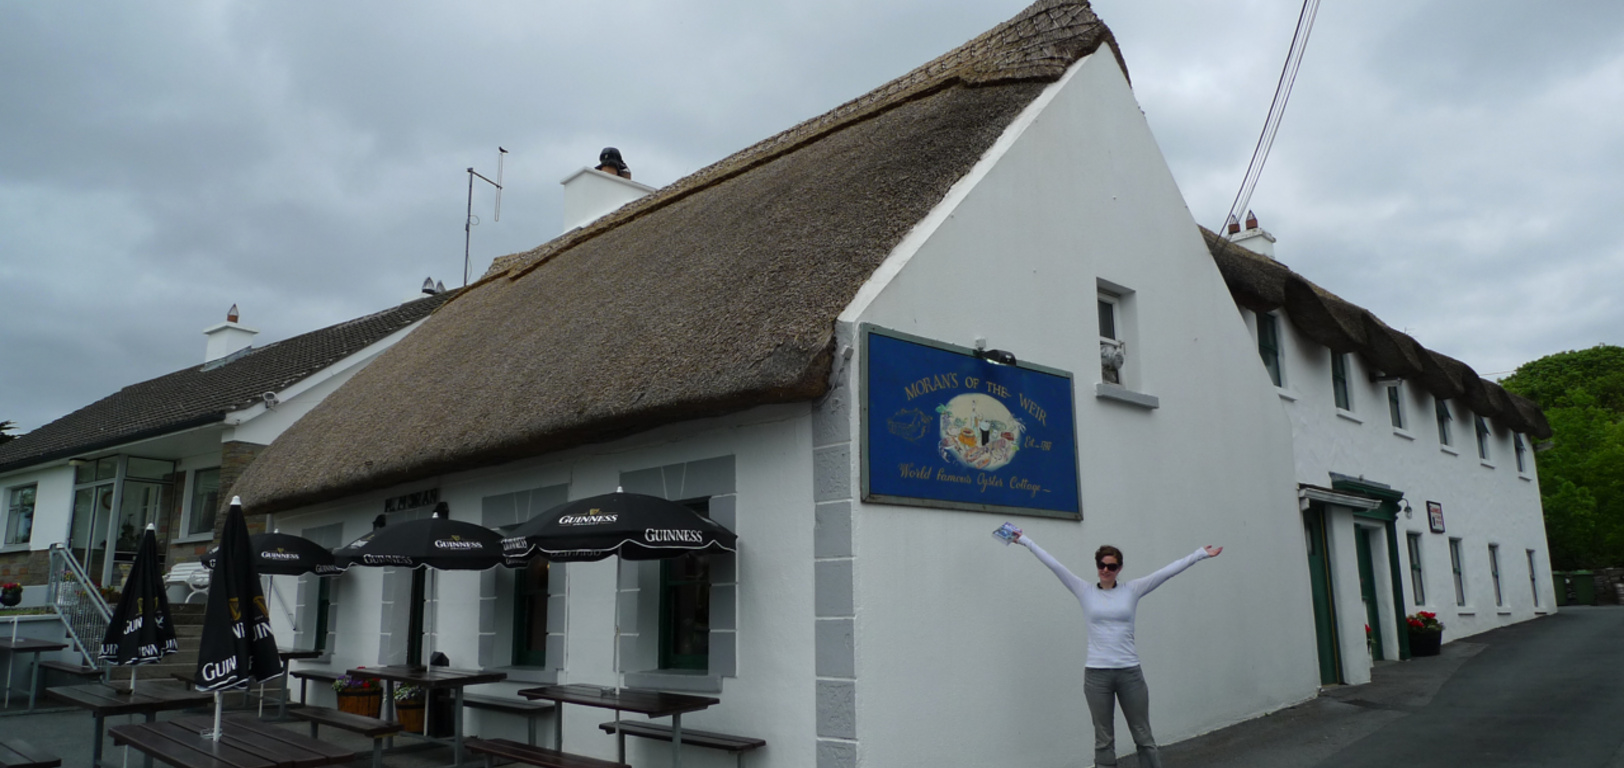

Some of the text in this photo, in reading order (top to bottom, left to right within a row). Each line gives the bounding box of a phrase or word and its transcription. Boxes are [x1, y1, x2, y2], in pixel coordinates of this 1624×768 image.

[904, 372, 959, 400] MORAN'S
[965, 376, 980, 389] OF
[1019, 393, 1047, 426] WEIR
[899, 463, 932, 480] World
[977, 472, 1003, 493] Oyster
[1009, 476, 1041, 498] Cottage
[558, 514, 618, 524] GUINNESS
[644, 528, 703, 544] GUINNESS
[434, 540, 483, 549] GUINNESS
[261, 551, 300, 560] GUINNESS
[363, 553, 413, 565] GUINNESS
[202, 654, 237, 681] GUIN
